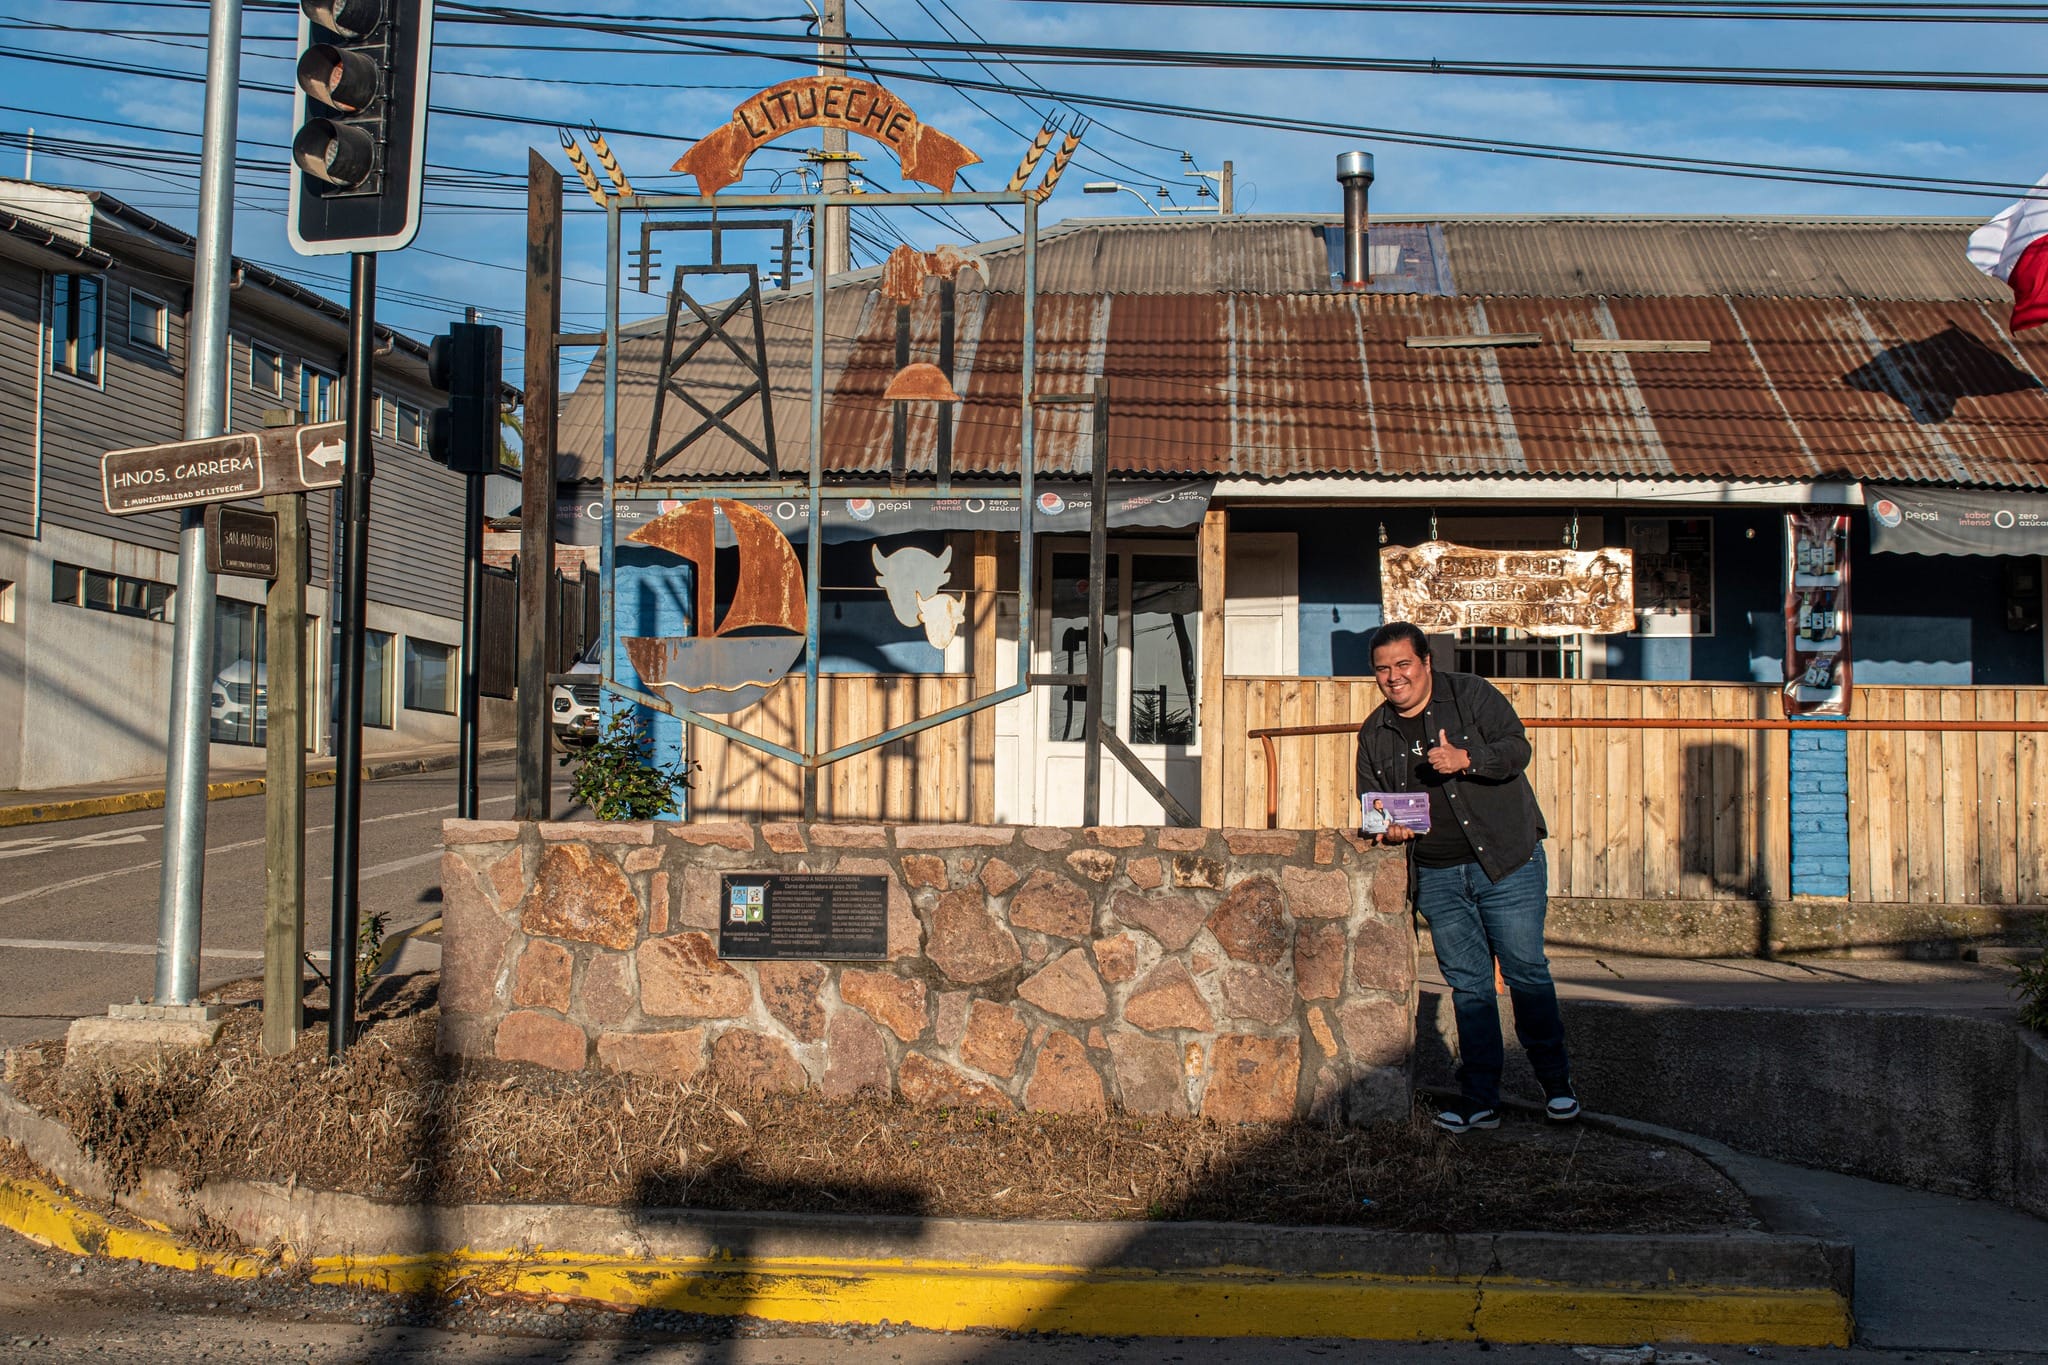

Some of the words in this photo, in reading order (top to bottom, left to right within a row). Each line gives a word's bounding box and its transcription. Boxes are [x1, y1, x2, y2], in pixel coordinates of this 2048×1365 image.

[739, 85, 911, 143] LITUECHE
[113, 468, 170, 489] HNOS.
[175, 457, 254, 479] CARRERA
[195, 488, 206, 496] DE
[207, 483, 244, 496] LITUECHE
[752, 503, 773, 511] abor
[878, 500, 912, 513] pepsi
[989, 504, 1020, 512] azúcar
[1068, 501, 1092, 511] pep
[616, 510, 641, 518] zúcar
[1905, 510, 1939, 521] pepsi
[1964, 511, 1990, 519] sabor
[1959, 518, 1991, 527] intenso
[224, 530, 239, 545] SAN
[240, 532, 273, 551] ANTONIO
[1439, 556, 1496, 577] BAR
[1466, 603, 1601, 626] ESQUINA
